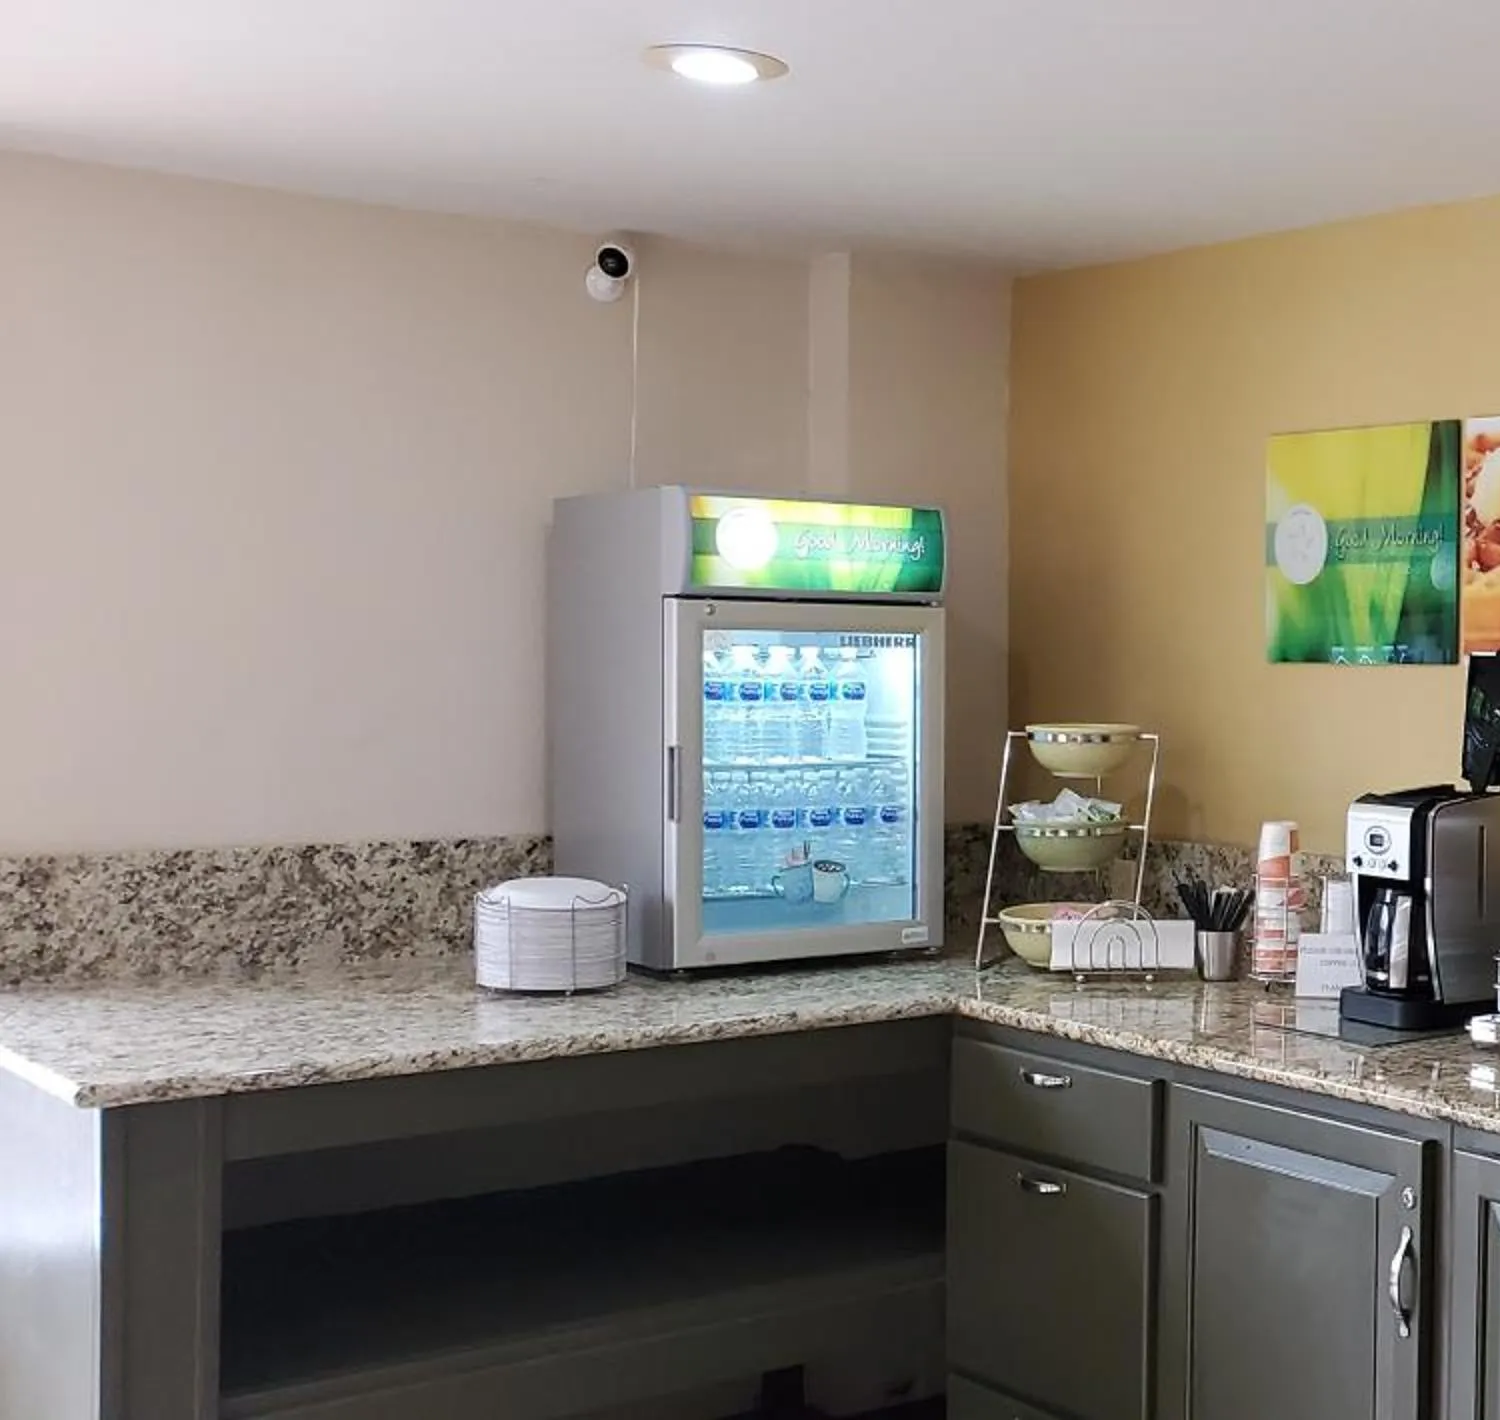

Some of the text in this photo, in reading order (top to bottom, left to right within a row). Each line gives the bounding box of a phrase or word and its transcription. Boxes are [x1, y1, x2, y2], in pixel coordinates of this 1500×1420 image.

[795, 528, 925, 561] Good Morning!
[1332, 521, 1445, 560] Good Morning!
